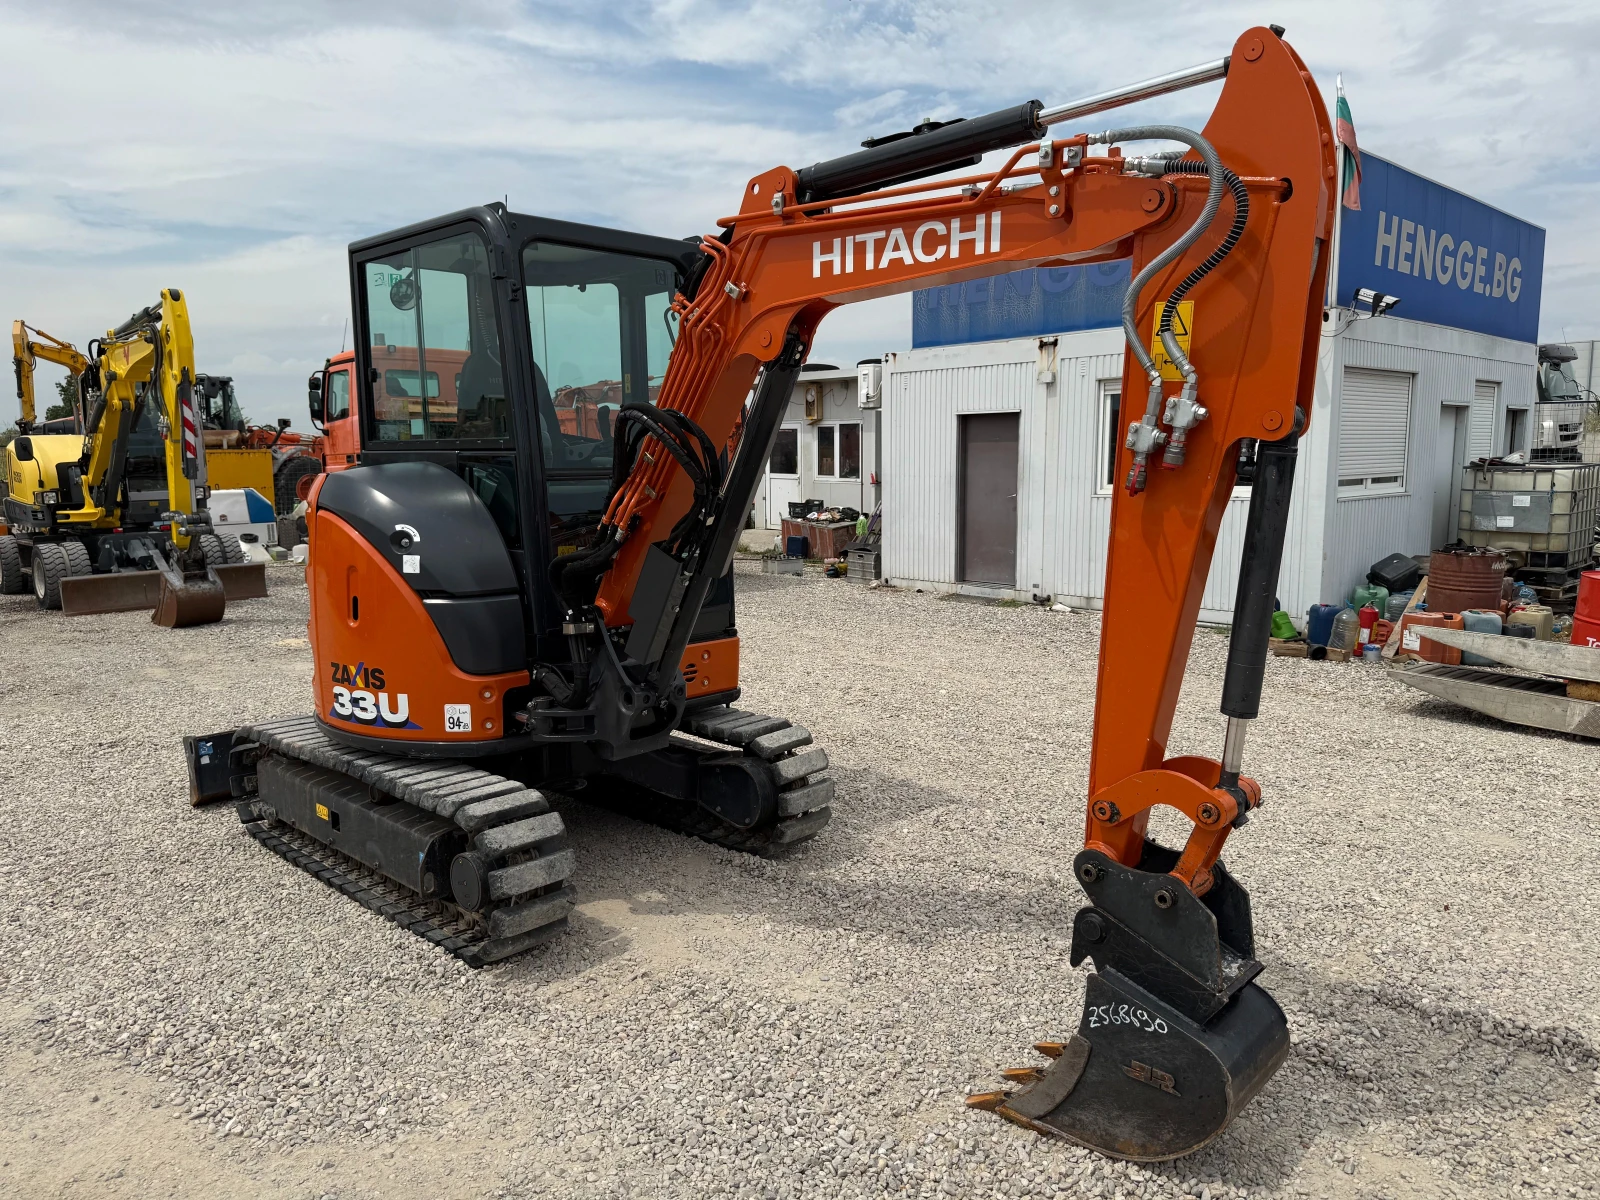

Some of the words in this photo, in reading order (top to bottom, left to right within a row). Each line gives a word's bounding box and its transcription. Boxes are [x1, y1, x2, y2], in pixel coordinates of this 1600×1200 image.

[812, 211, 1001, 279] HITACHI
[1375, 210, 1522, 303] HENGGE.BG
[331, 662, 386, 690] ZAXIS
[333, 686, 410, 727] 33U
[448, 716, 463, 730] 94
